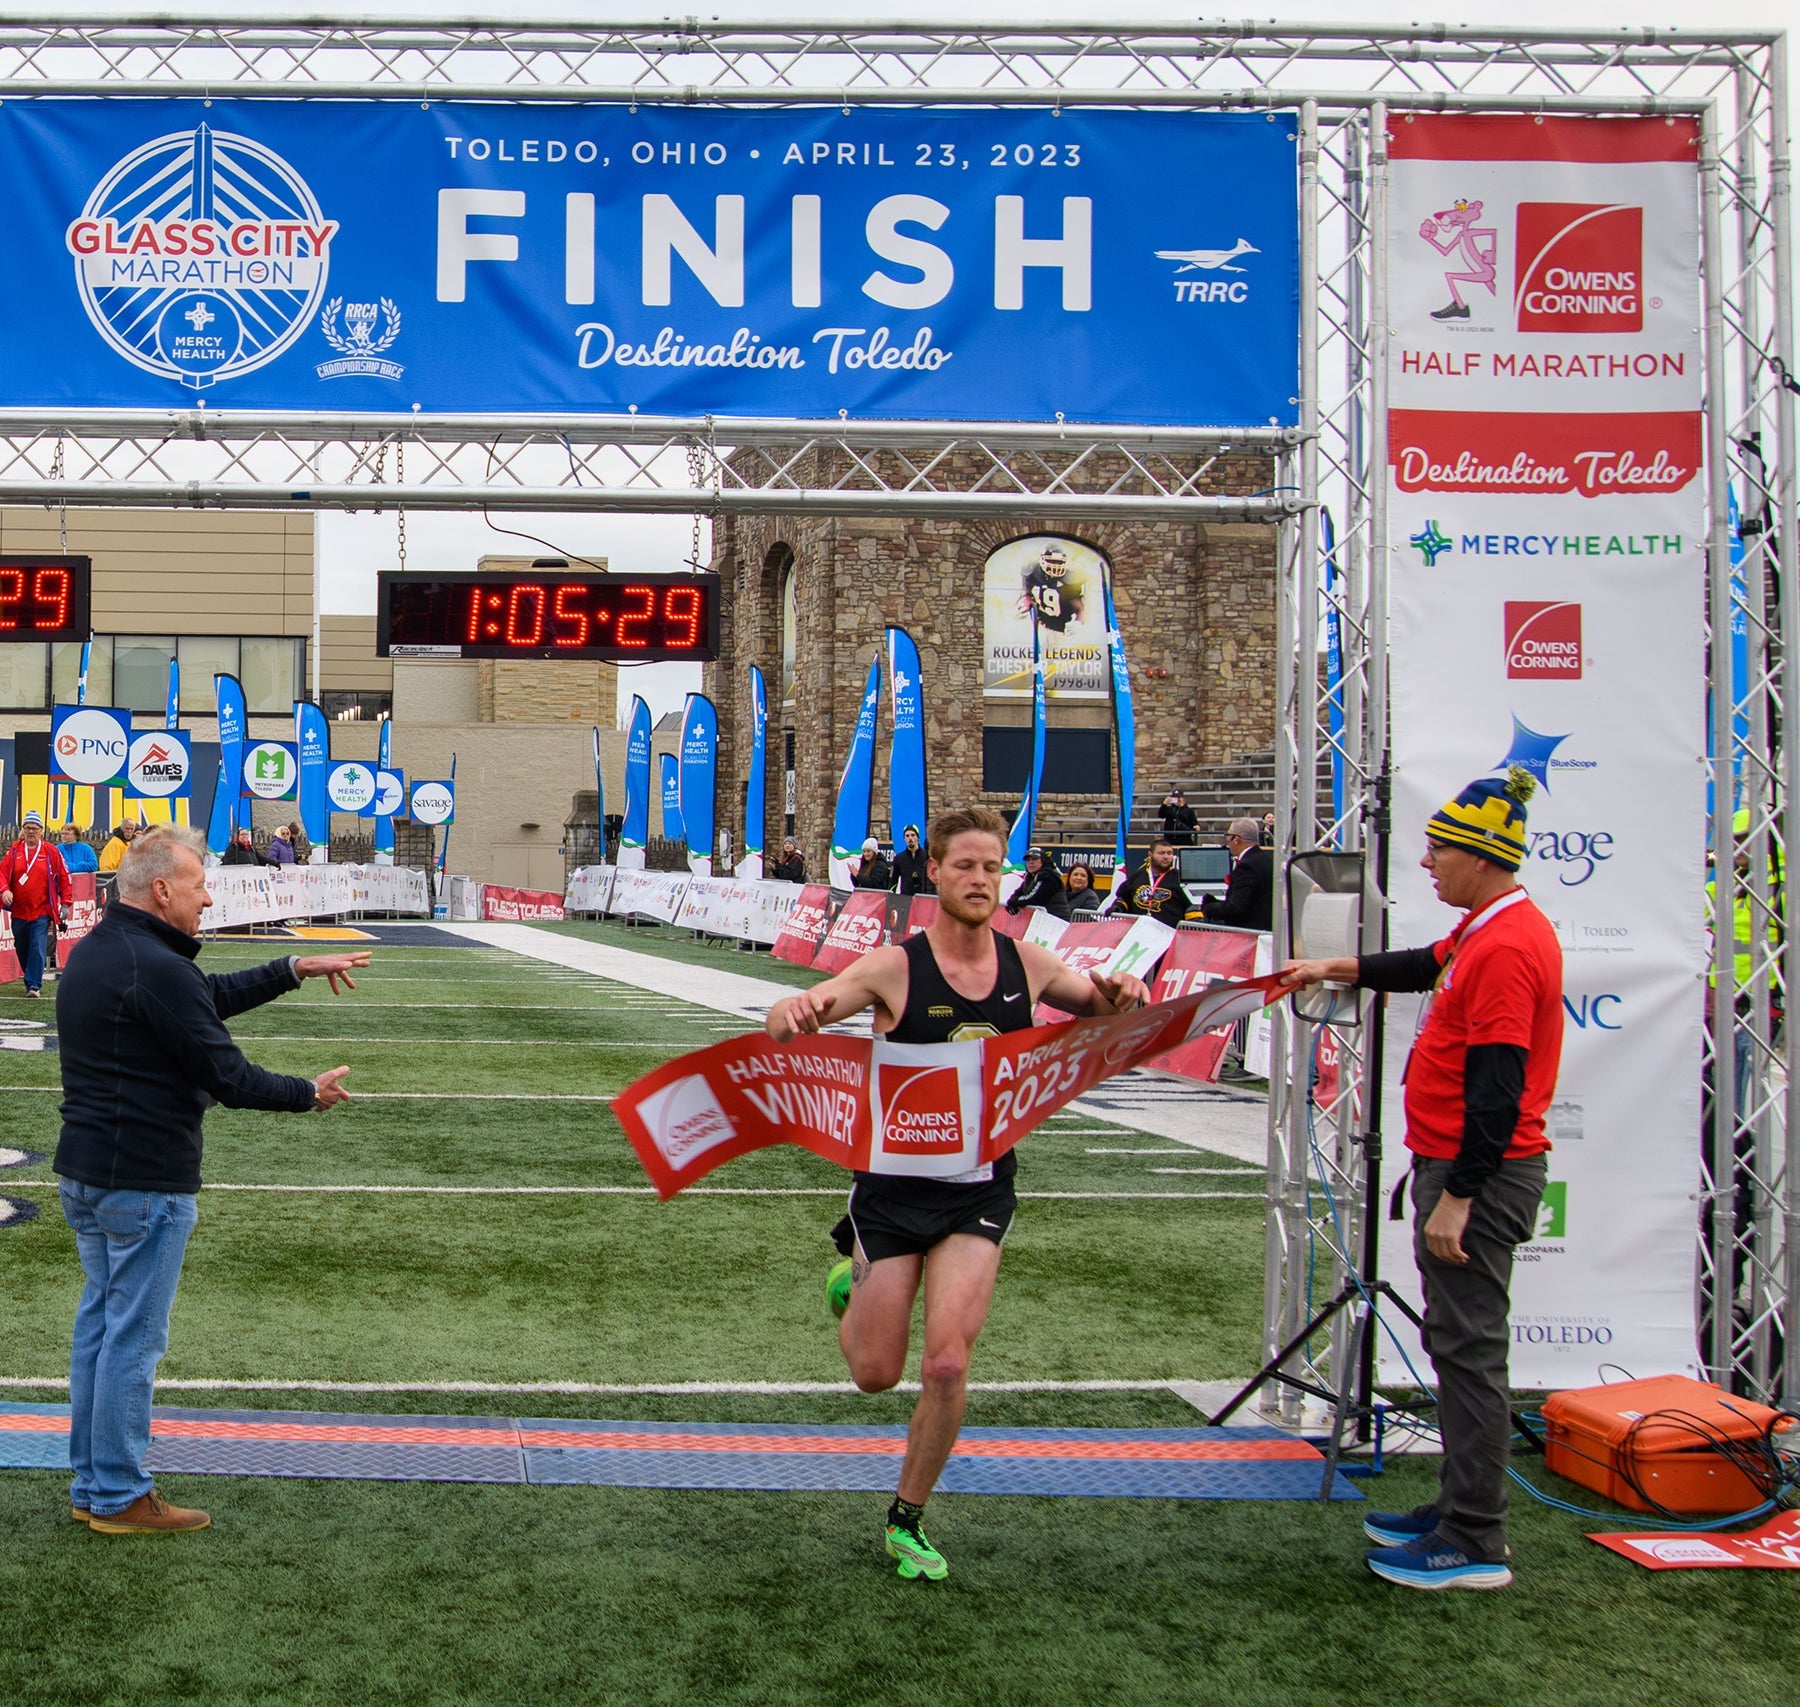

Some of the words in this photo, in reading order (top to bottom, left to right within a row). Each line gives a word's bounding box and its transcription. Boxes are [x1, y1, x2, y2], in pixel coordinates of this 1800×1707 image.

[445, 136, 612, 168] TOLEDO,
[631, 140, 729, 166] OHIO
[781, 142, 896, 167] APRIL
[915, 142, 970, 171] 23,
[990, 143, 1083, 168] 2023
[71, 221, 216, 256] GLASS
[230, 224, 335, 257] CITY
[436, 188, 1093, 313] FINISH
[111, 259, 293, 284] MARATHON
[1544, 267, 1637, 292] OWENS
[1173, 281, 1250, 304] TRRC
[344, 303, 378, 319] RRCA
[1524, 291, 1637, 315] CORNING
[175, 336, 223, 348] MERCY
[575, 322, 806, 371] Destination
[811, 326, 953, 373] Toledo
[172, 348, 226, 360] HEALTH
[316, 360, 379, 379] CHAMPIONSHIP
[379, 362, 405, 379] RACE
[1401, 350, 1481, 376] HALF
[1493, 352, 1685, 378] MARATHON
[1400, 446, 1570, 485] Destination
[1573, 449, 1687, 489] Toledo
[1461, 534, 1683, 556] MERCYHEALTH
[1031, 584, 1061, 617] 19
[993, 646, 1035, 659] ROCKE
[1045, 647, 1102, 660] LEGENDS
[1521, 640, 1578, 655] OWENS
[1054, 659, 1103, 676] TAYLOR
[1510, 654, 1578, 669] CORNING
[1053, 677, 1101, 689] 1998-01
[221, 720, 237, 728] MERCY
[82, 738, 124, 757] PNC
[142, 763, 182, 776] DAVE'S
[1550, 759, 1598, 769] BlueScope
[413, 798, 452, 814] savage
[1582, 926, 1628, 937] TOLEDO
[1563, 994, 1623, 1030] NC
[724, 1053, 788, 1084] HALF
[787, 1053, 865, 1088] MARATHON
[993, 1041, 1064, 1086] APRIL
[989, 1048, 1088, 1141] 2023
[740, 1082, 857, 1148] WINNER
[897, 1109, 957, 1127] OWENS
[886, 1123, 959, 1143] CORNING
[1512, 1315, 1529, 1323] THE
[1534, 1316, 1595, 1324] UNIVERSITY
[1601, 1316, 1611, 1324] OF
[1511, 1325, 1613, 1345] TOLEDO
[1553, 1345, 1571, 1353] 1872
[1427, 1553, 1469, 1570] HOKA
